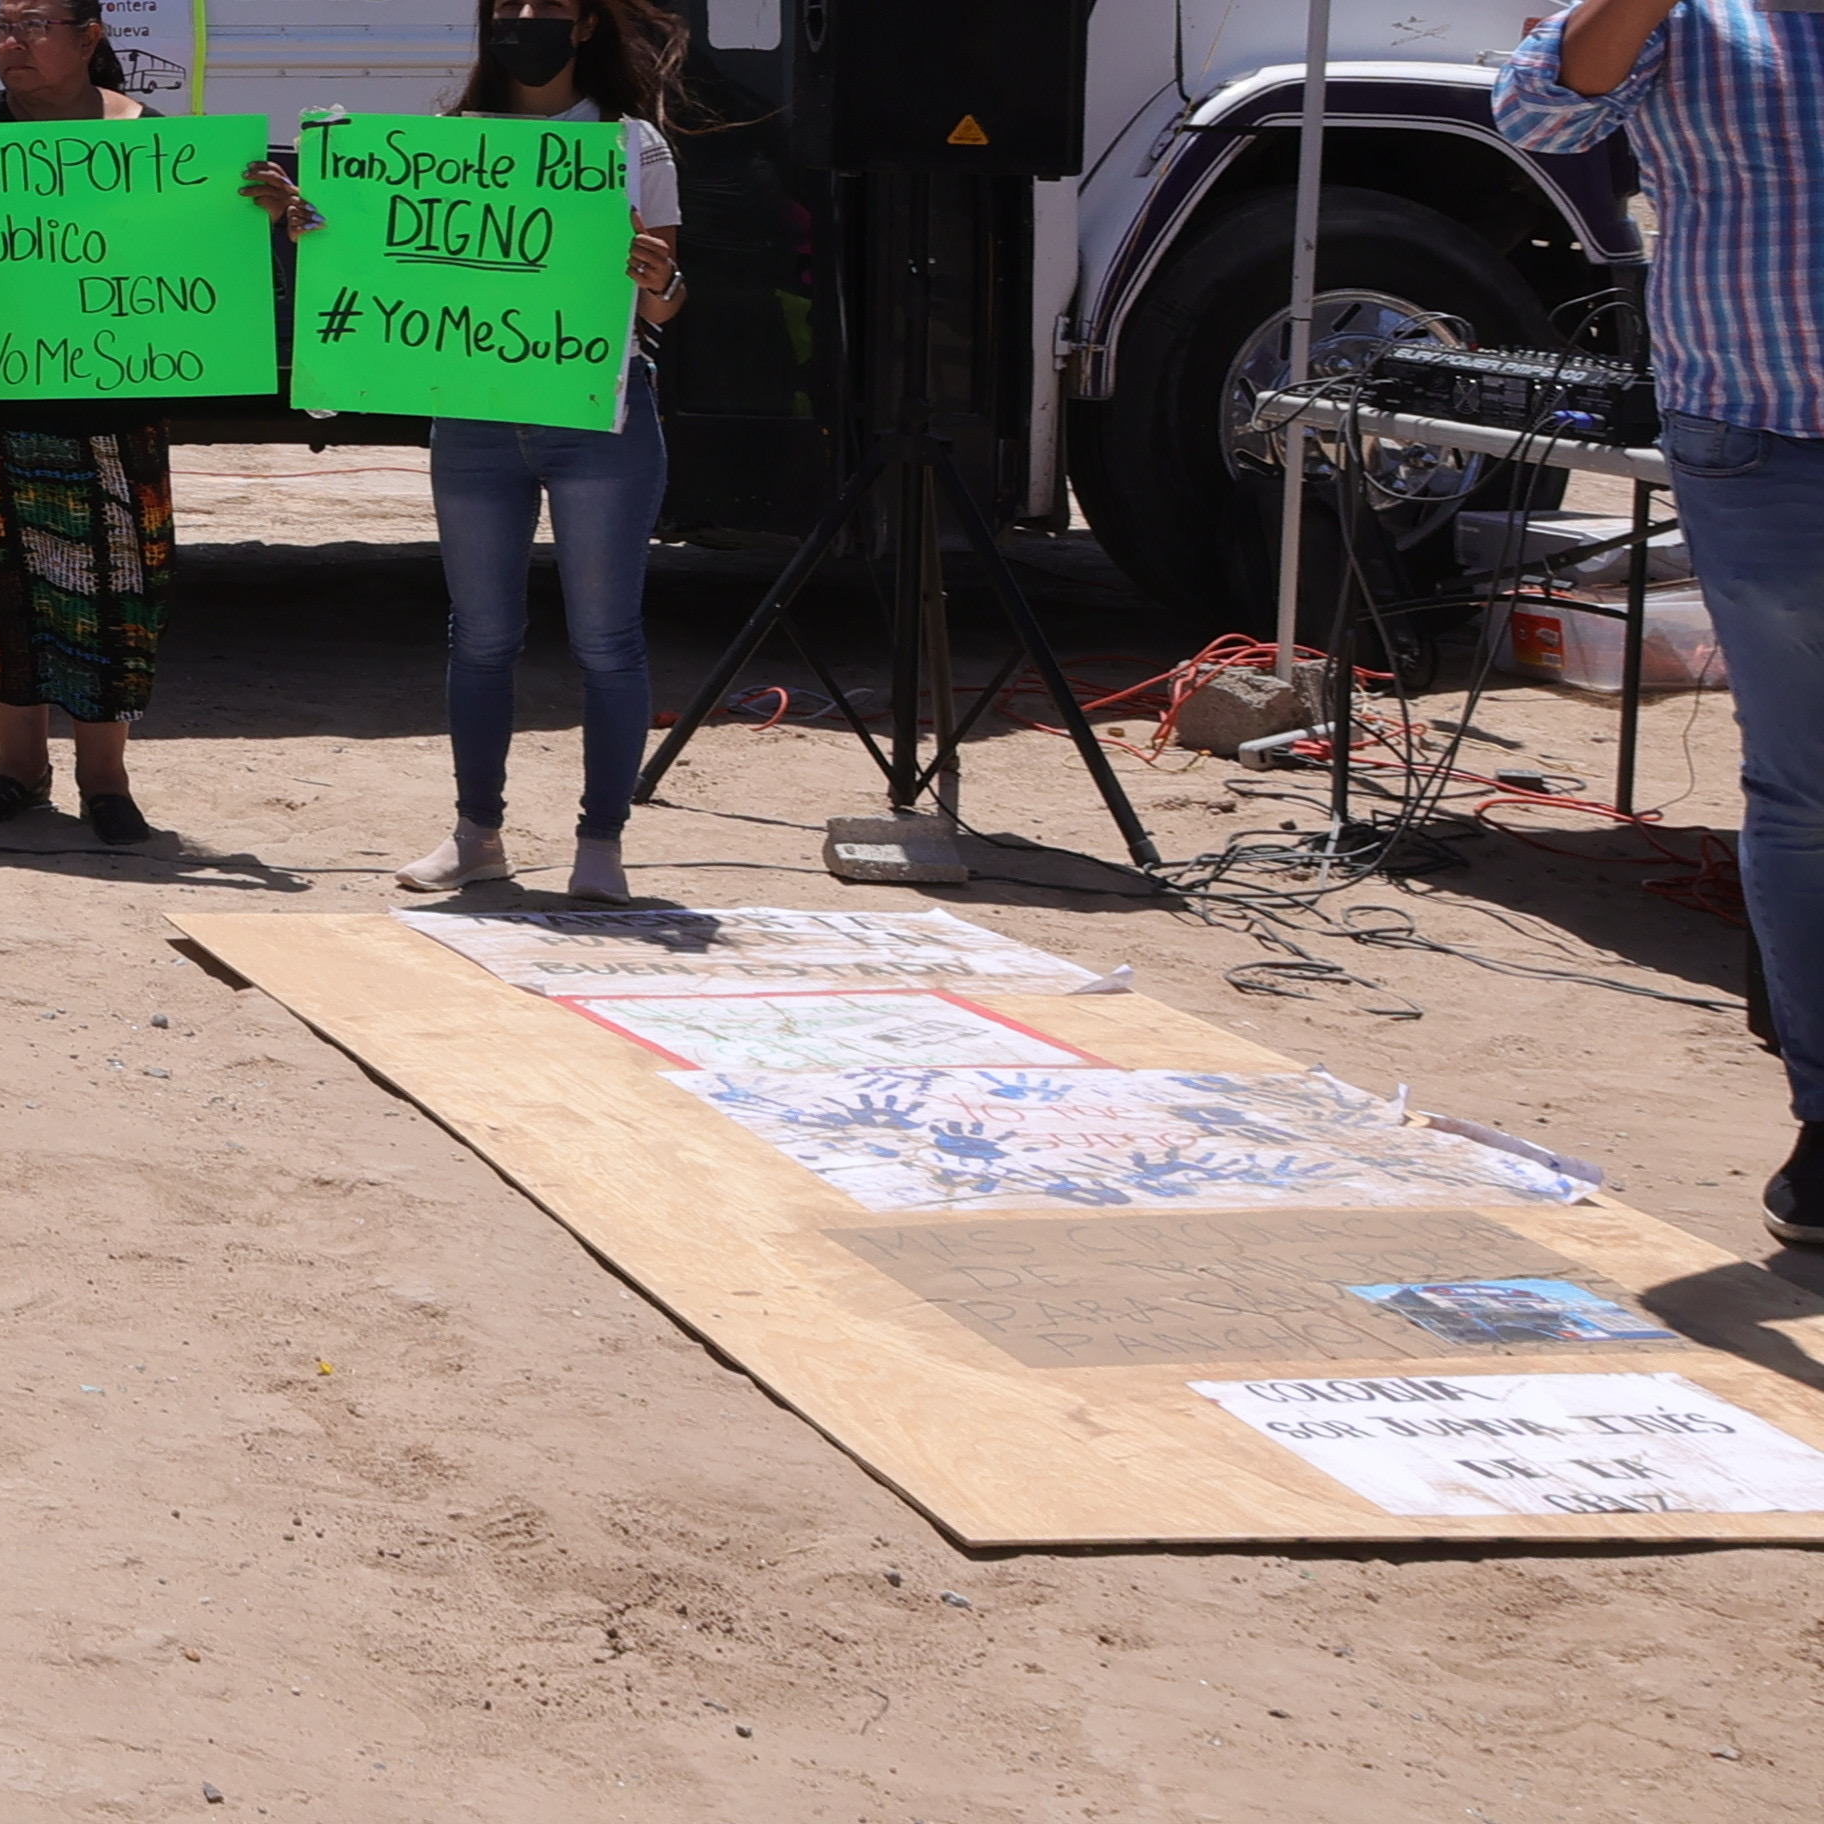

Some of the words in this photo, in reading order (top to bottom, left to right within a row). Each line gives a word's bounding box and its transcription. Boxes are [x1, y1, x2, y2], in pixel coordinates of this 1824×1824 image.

[385, 194, 554, 265] DIGNO
[78, 275, 217, 317] DIGNO
[316, 285, 611, 365] #YoMeSubo
[532, 960, 699, 977] BUEN
[731, 960, 979, 977] ESTADO
[953, 1265, 1080, 1292] DE
[1244, 1376, 1504, 1403] COLONIA
[1265, 1419, 1378, 1440] SOR
[1365, 1415, 1566, 1440] JUANA
[1566, 1405, 1738, 1435] INÉS
[1453, 1457, 1553, 1480] DE
[1565, 1457, 1676, 1480] LA
[1542, 1493, 1695, 1514] CRUZ
